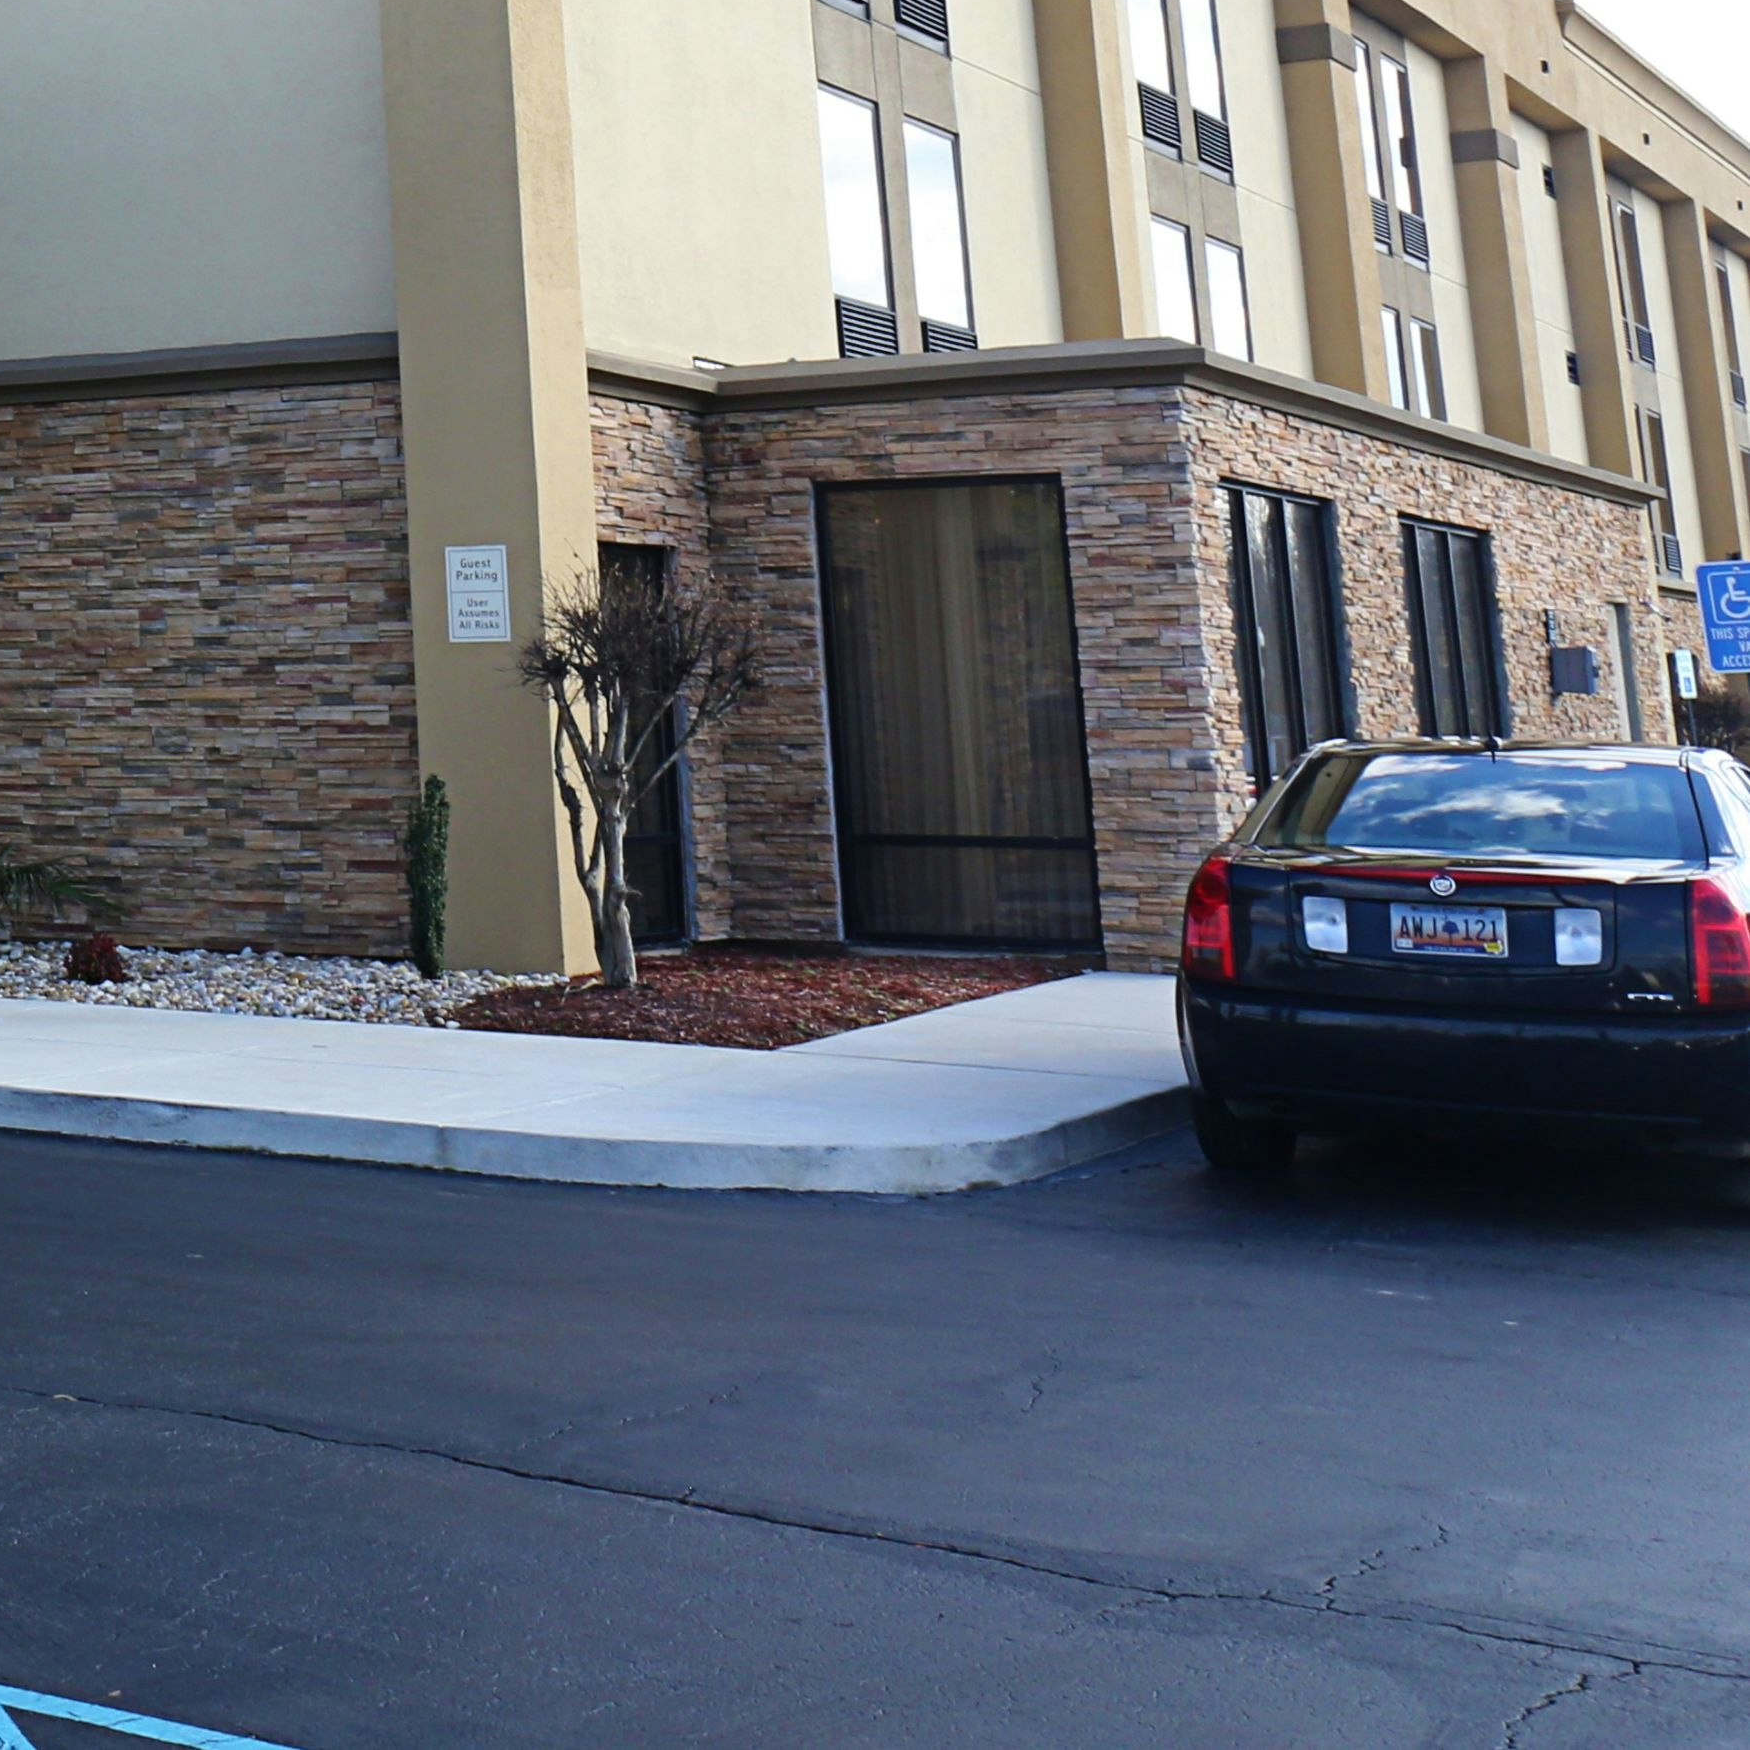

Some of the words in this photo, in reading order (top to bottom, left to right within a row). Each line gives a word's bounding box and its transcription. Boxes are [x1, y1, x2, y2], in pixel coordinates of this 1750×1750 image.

[460, 558, 491, 568] Guest
[456, 570, 498, 582] Parking
[467, 598, 488, 607] User
[458, 609, 499, 617] Assumes
[459, 621, 471, 629] All
[475, 620, 499, 628] Risks
[1710, 627, 1734, 640] THIS
[1400, 915, 1438, 939] AWJ
[1461, 918, 1499, 942] 121
